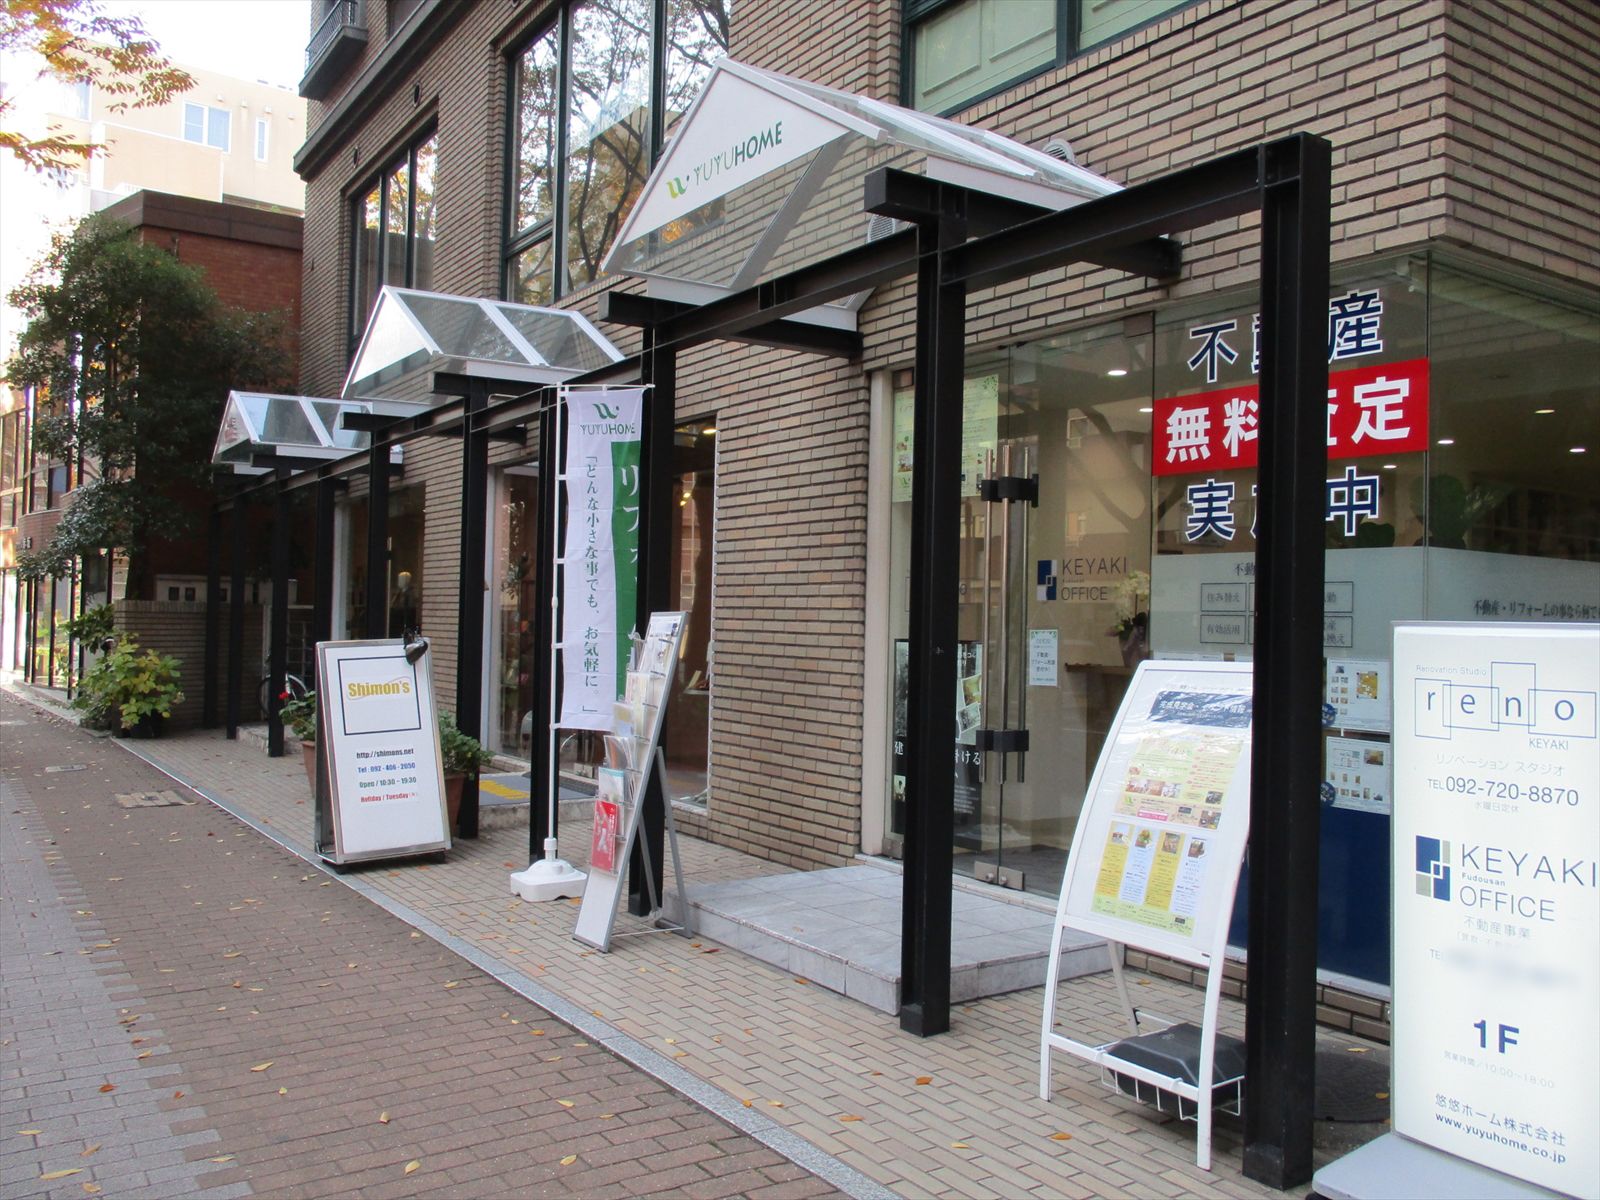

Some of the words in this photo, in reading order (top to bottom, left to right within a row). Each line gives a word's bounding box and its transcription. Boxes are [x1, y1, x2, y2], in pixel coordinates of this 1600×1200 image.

[693, 121, 783, 186] YUYUHOME
[1187, 289, 1384, 384] 不産
[580, 423, 636, 436] YUYUHOME
[1165, 376, 1411, 463] 無料定
[1185, 465, 1379, 541] 実中
[1062, 557, 1128, 576] KEYAKI
[1061, 586, 1108, 601] OFFICE
[1459, 665, 1487, 677] Studio
[348, 680, 411, 697] Shimon's
[356, 748, 414, 760] http://shimons.net
[1529, 738, 1569, 751] KEYAKI
[1434, 752, 1509, 771] リノベーション
[1516, 760, 1566, 777] スタジオ
[1445, 776, 1580, 807] 092-720-8870
[1461, 843, 1598, 888] KEYAKI
[1461, 873, 1506, 887] Fudousan
[1460, 885, 1556, 922] OFFICE
[1463, 917, 1531, 939] 不動産事業
[1435, 1093, 1566, 1147] 悠悠ホーム株式会社
[1435, 1111, 1566, 1165] www.yuyuhome.co.jp
